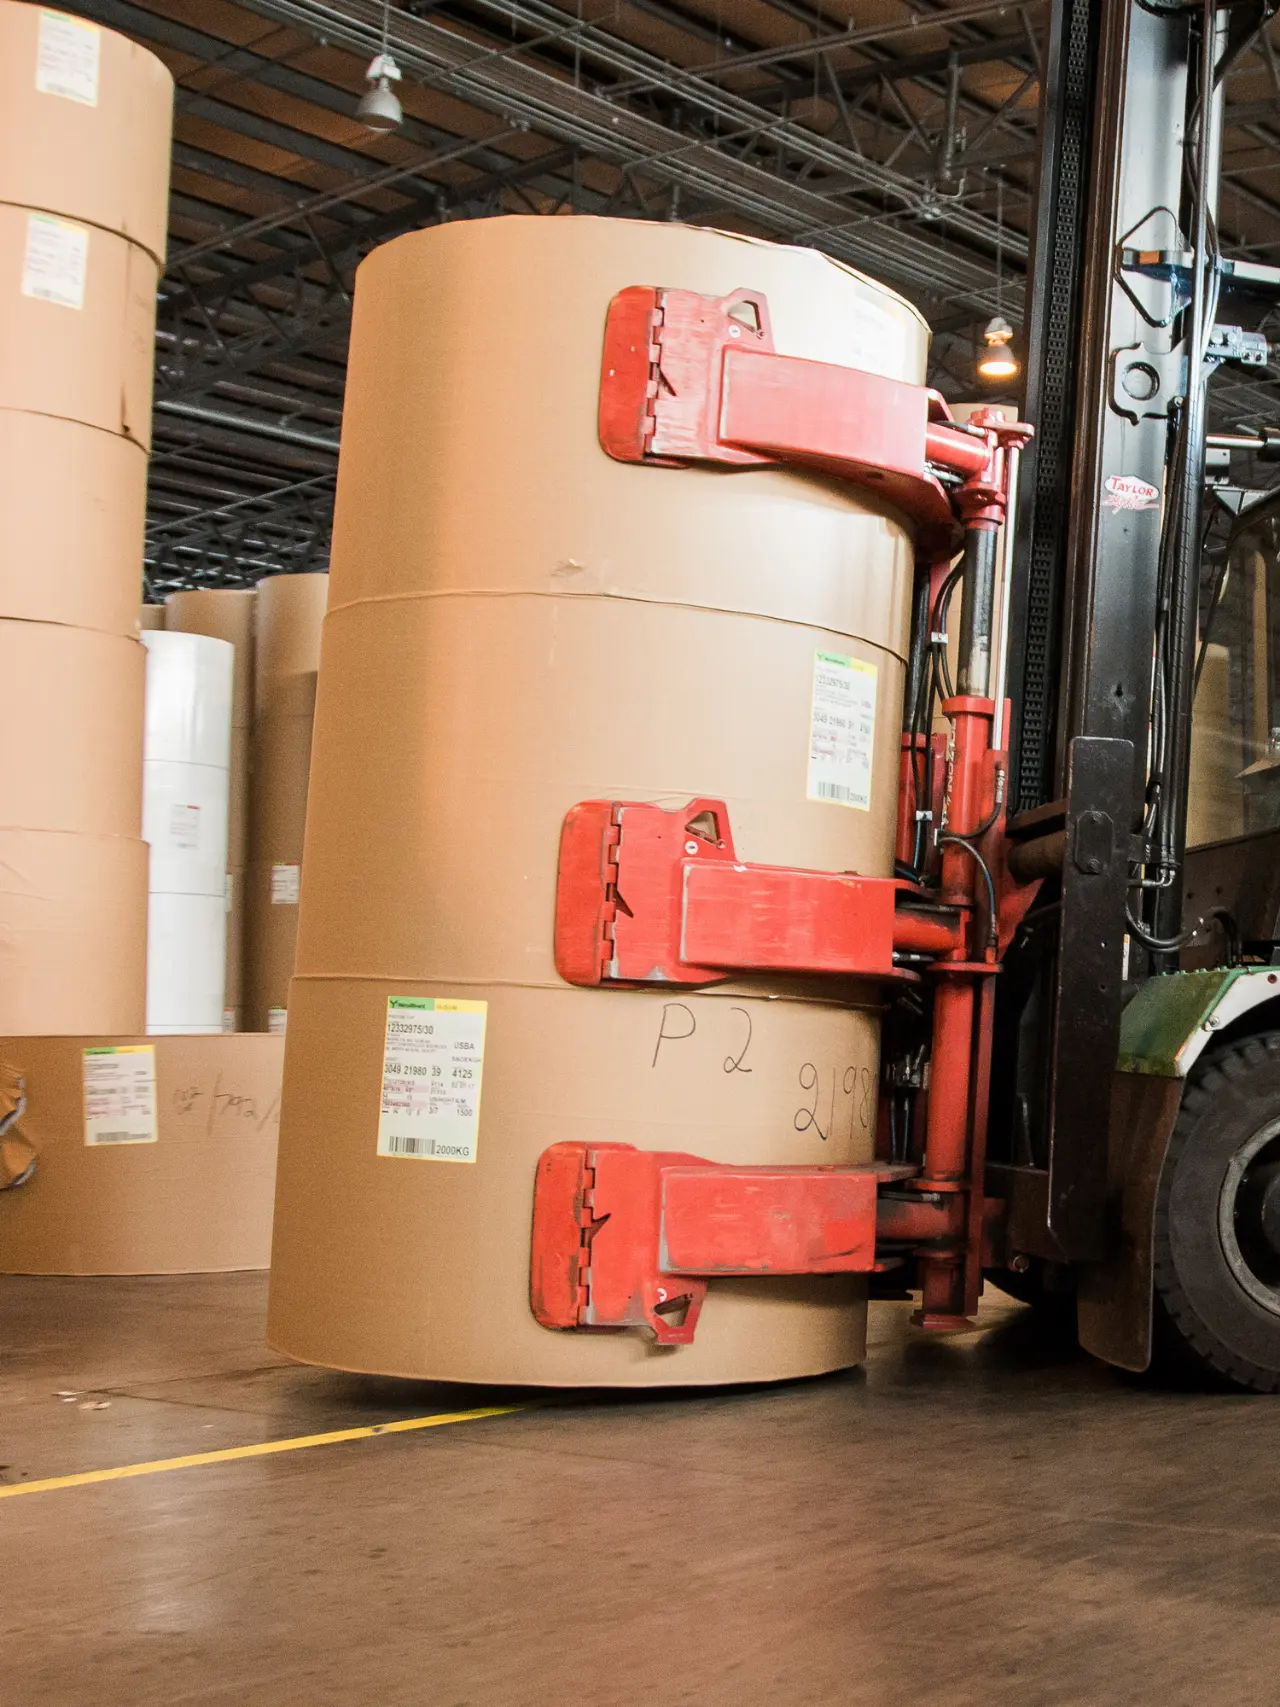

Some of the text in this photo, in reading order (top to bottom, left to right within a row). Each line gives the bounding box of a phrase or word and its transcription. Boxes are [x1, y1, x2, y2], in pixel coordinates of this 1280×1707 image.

[1111, 477, 1153, 497] TAYLOR
[652, 1002, 753, 1074] P 2
[436, 1145, 470, 1156] 2000KG
